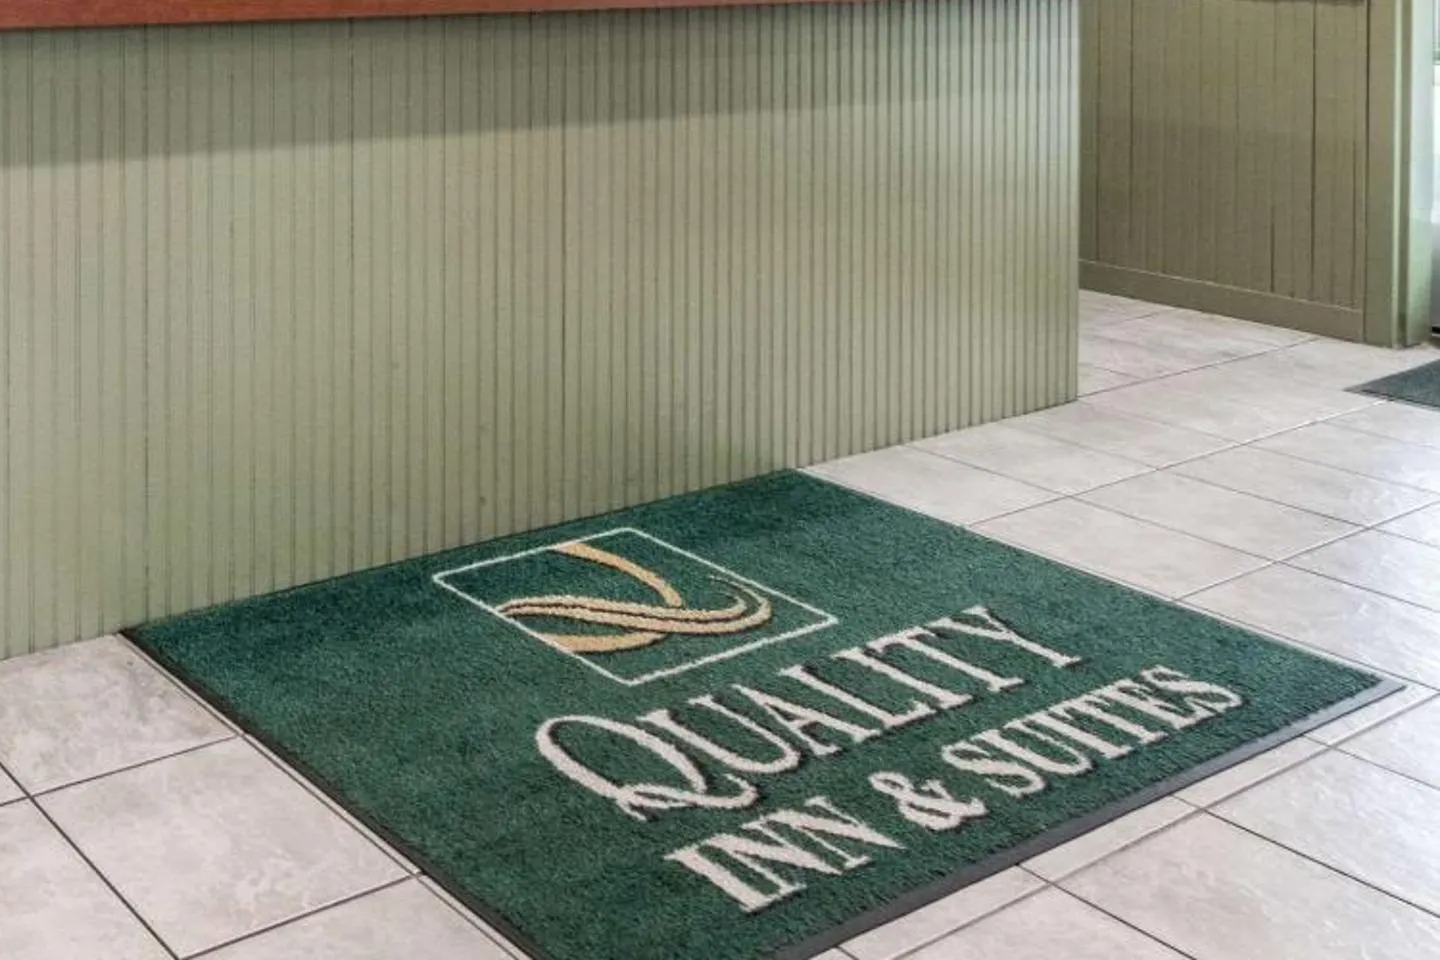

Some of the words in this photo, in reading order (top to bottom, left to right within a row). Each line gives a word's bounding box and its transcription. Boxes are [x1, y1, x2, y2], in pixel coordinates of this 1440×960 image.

[535, 605, 1083, 822] QUALITY
[664, 795, 906, 913] INN
[868, 770, 988, 831] &
[942, 664, 1245, 799] SUITES
